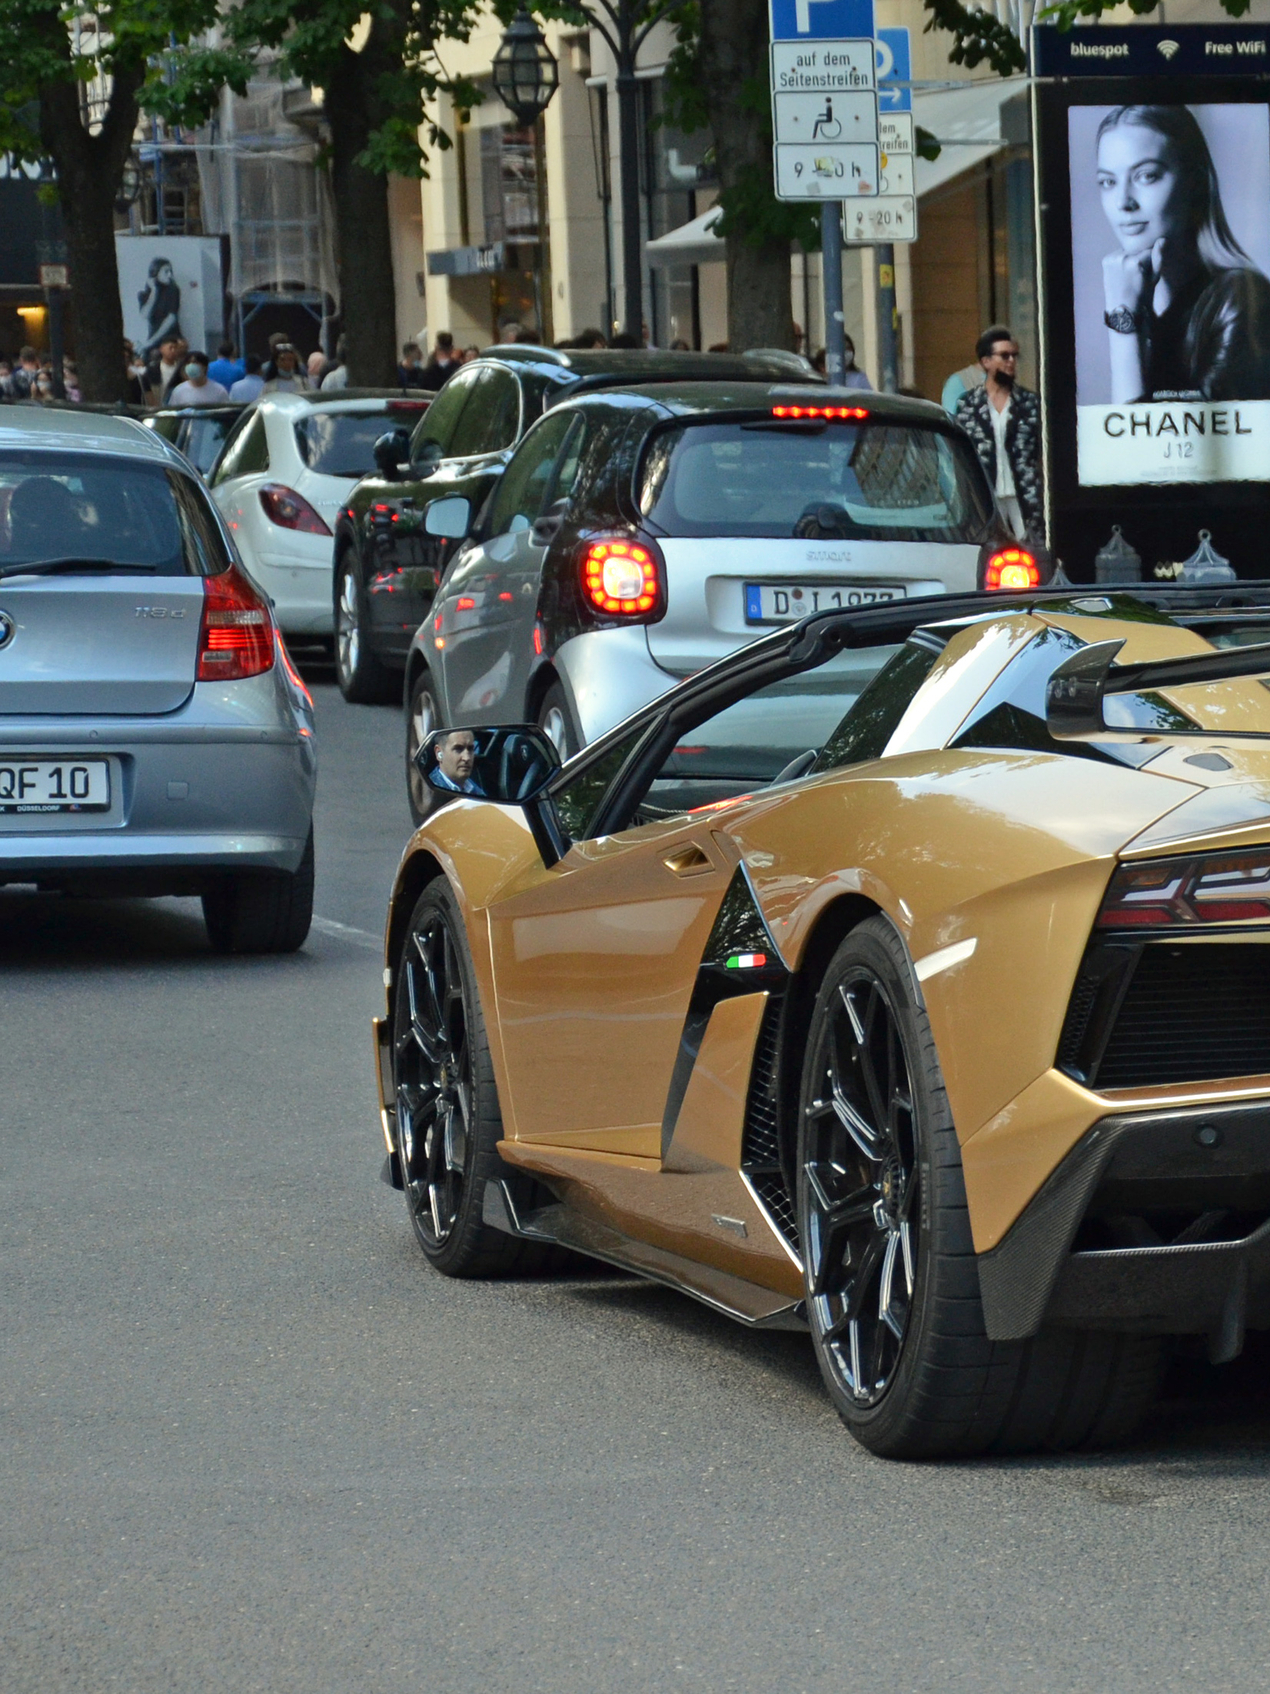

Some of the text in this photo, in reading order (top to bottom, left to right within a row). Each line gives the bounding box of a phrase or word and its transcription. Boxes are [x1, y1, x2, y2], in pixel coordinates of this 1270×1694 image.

[1070, 41, 1130, 60] bluespot
[1205, 40, 1267, 55] Free WiFi
[796, 51, 850, 67] auf dem
[780, 72, 868, 87] Seitenstreifen
[794, 161, 803, 178] 9
[851, 161, 862, 178] h
[856, 212, 864, 225] 9
[895, 211, 903, 225] h
[1103, 410, 1252, 438] CHANEL
[806, 550, 852, 562] smart
[774, 590, 789, 615] D
[48, 766, 90, 799] 10
